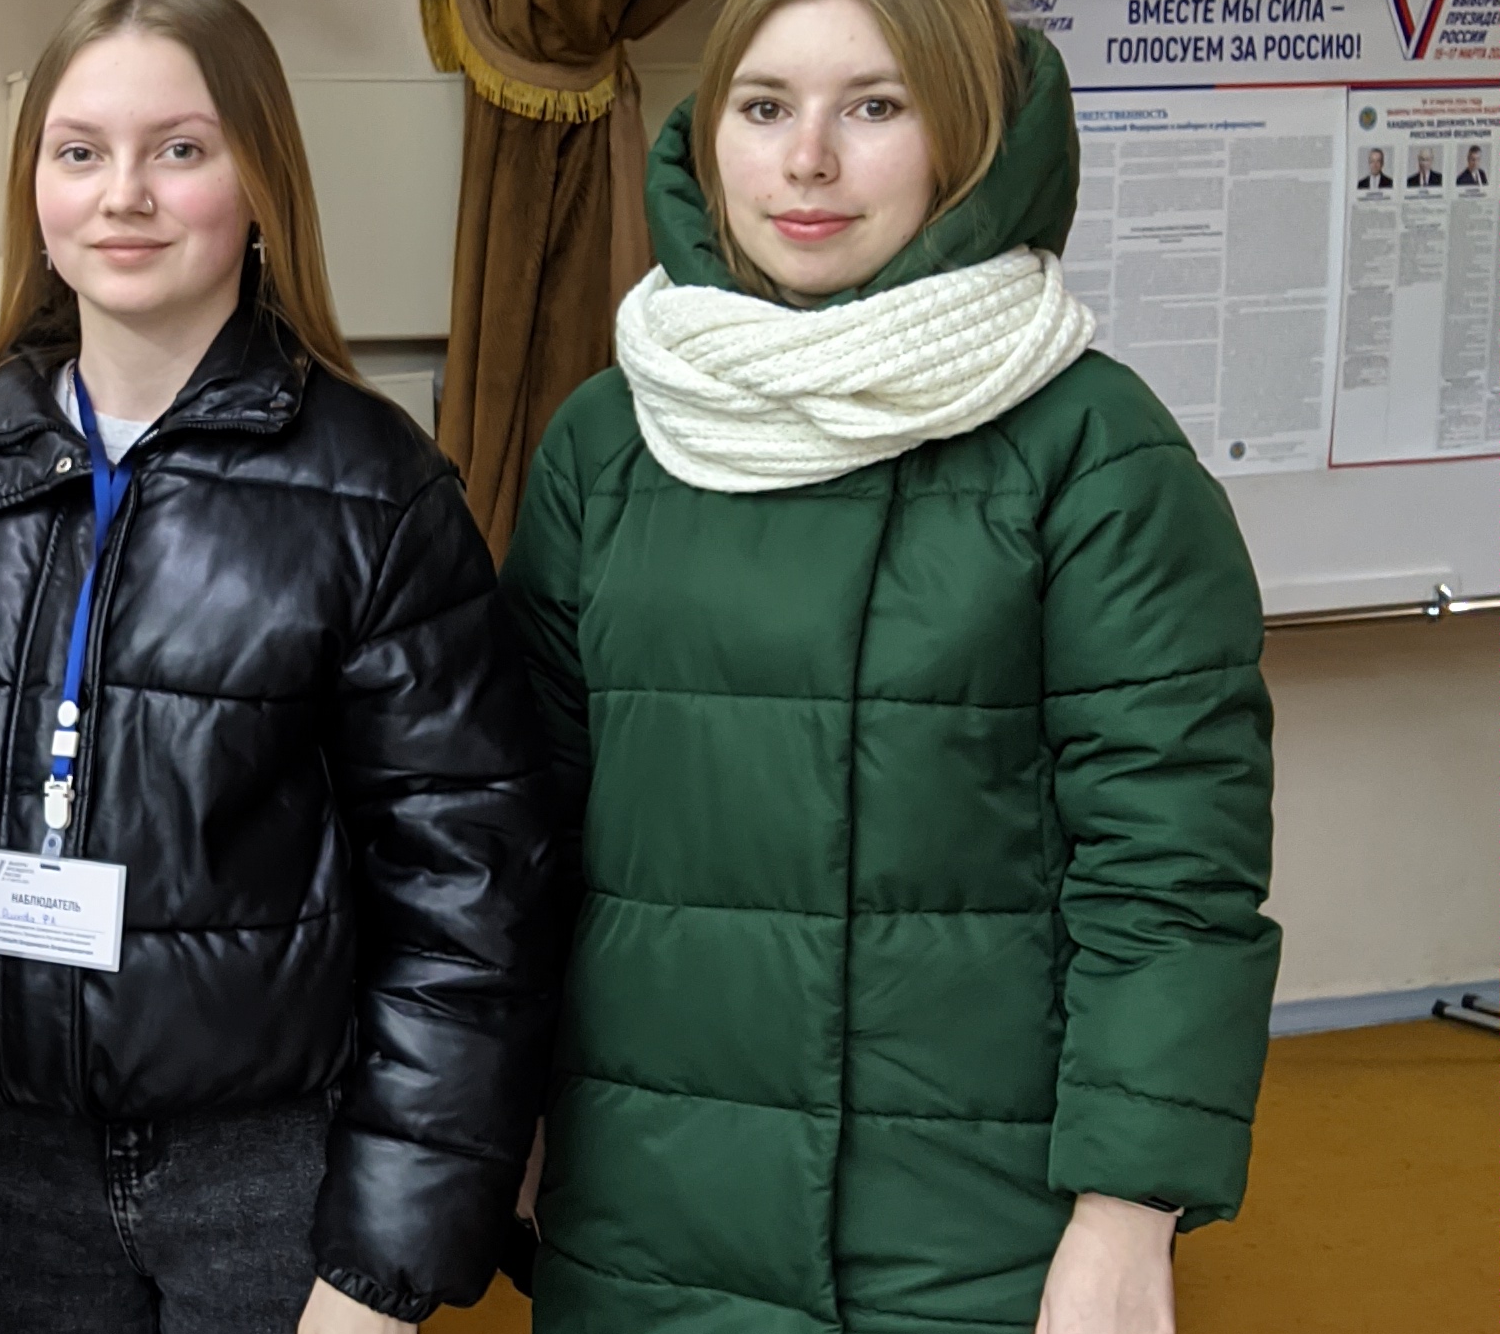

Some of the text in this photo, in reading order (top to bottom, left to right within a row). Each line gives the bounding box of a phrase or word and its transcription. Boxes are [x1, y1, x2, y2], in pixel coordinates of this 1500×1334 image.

[1445, 11, 1500, 26] ПРЕЗИДЕ
[1439, 29, 1487, 44] РОССИИ
[1107, 33, 1362, 63] ГОЛОСУЕМ ЗА РОССИЮ!
[11, 893, 82, 913] НАБЛЮДАТЕЛЬ
